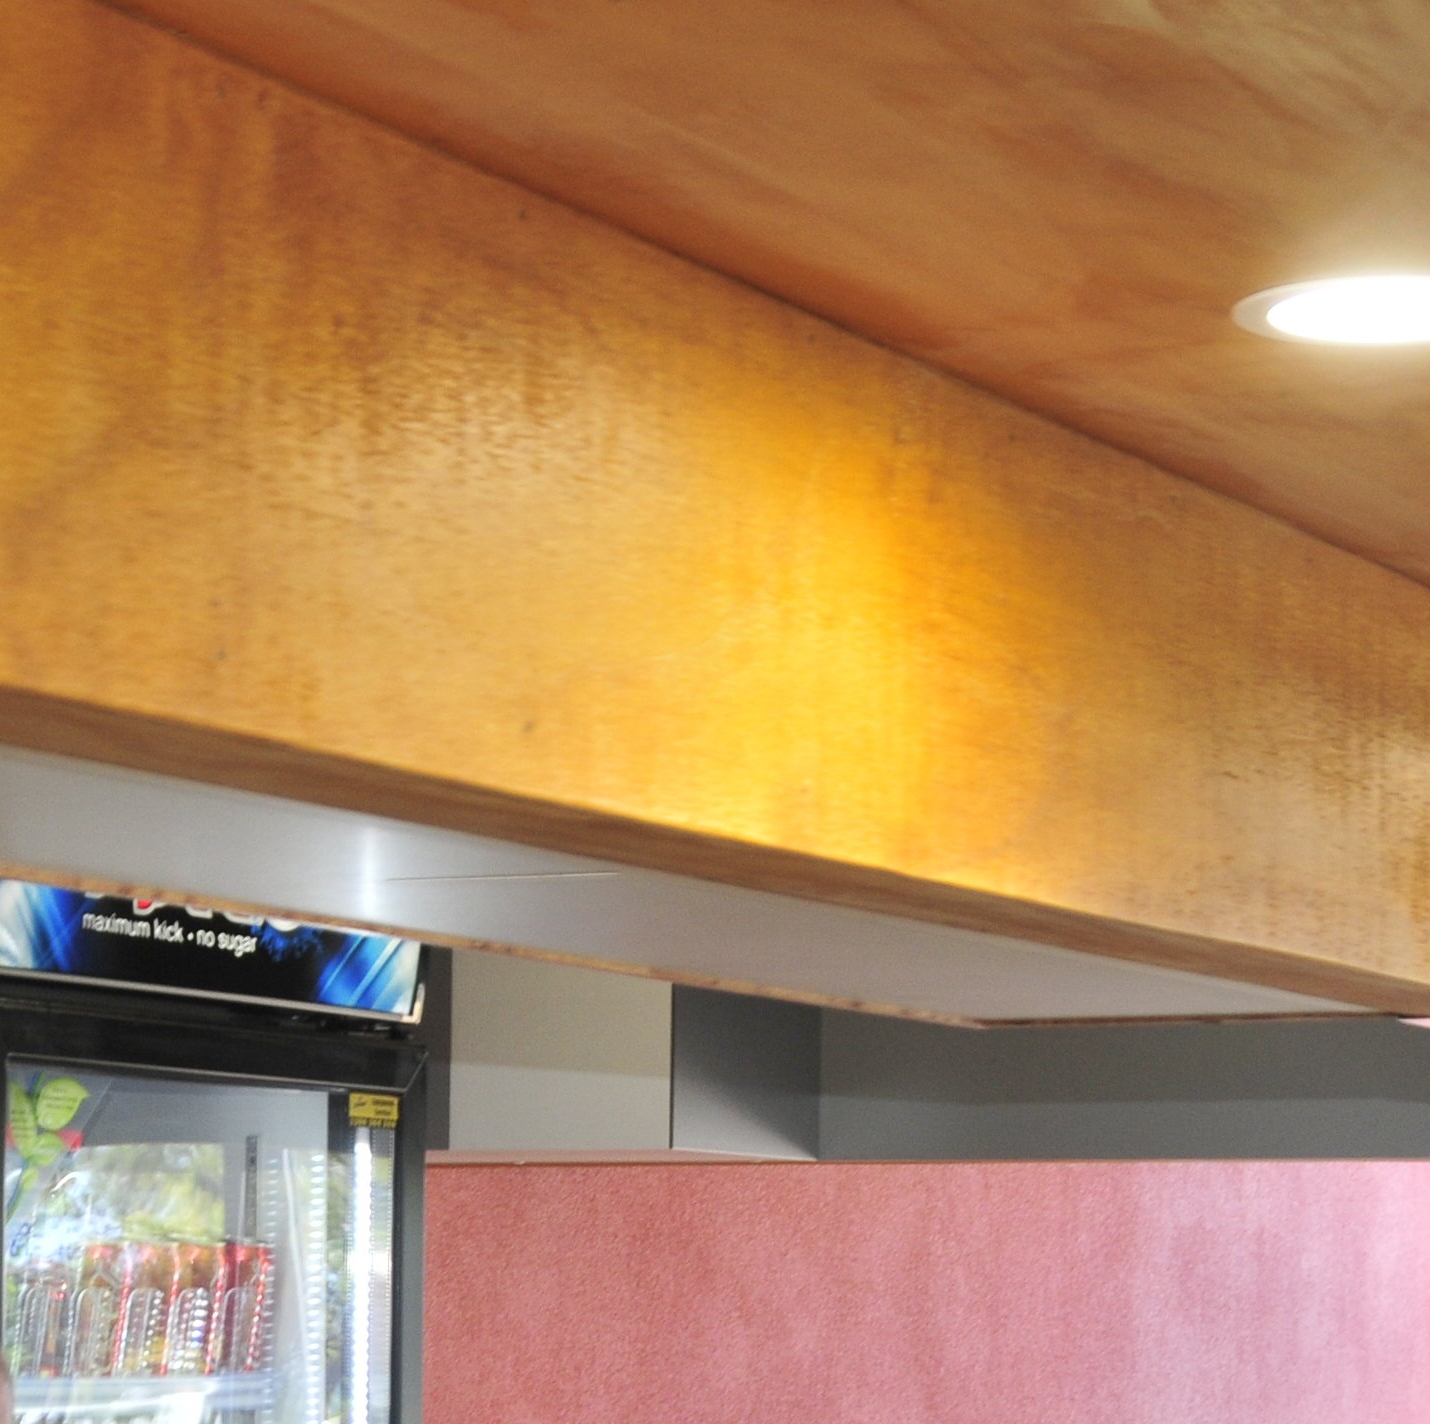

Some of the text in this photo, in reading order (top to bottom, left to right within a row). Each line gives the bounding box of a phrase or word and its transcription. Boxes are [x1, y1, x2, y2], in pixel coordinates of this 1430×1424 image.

[82, 912, 258, 957] maximum kick no sugar
